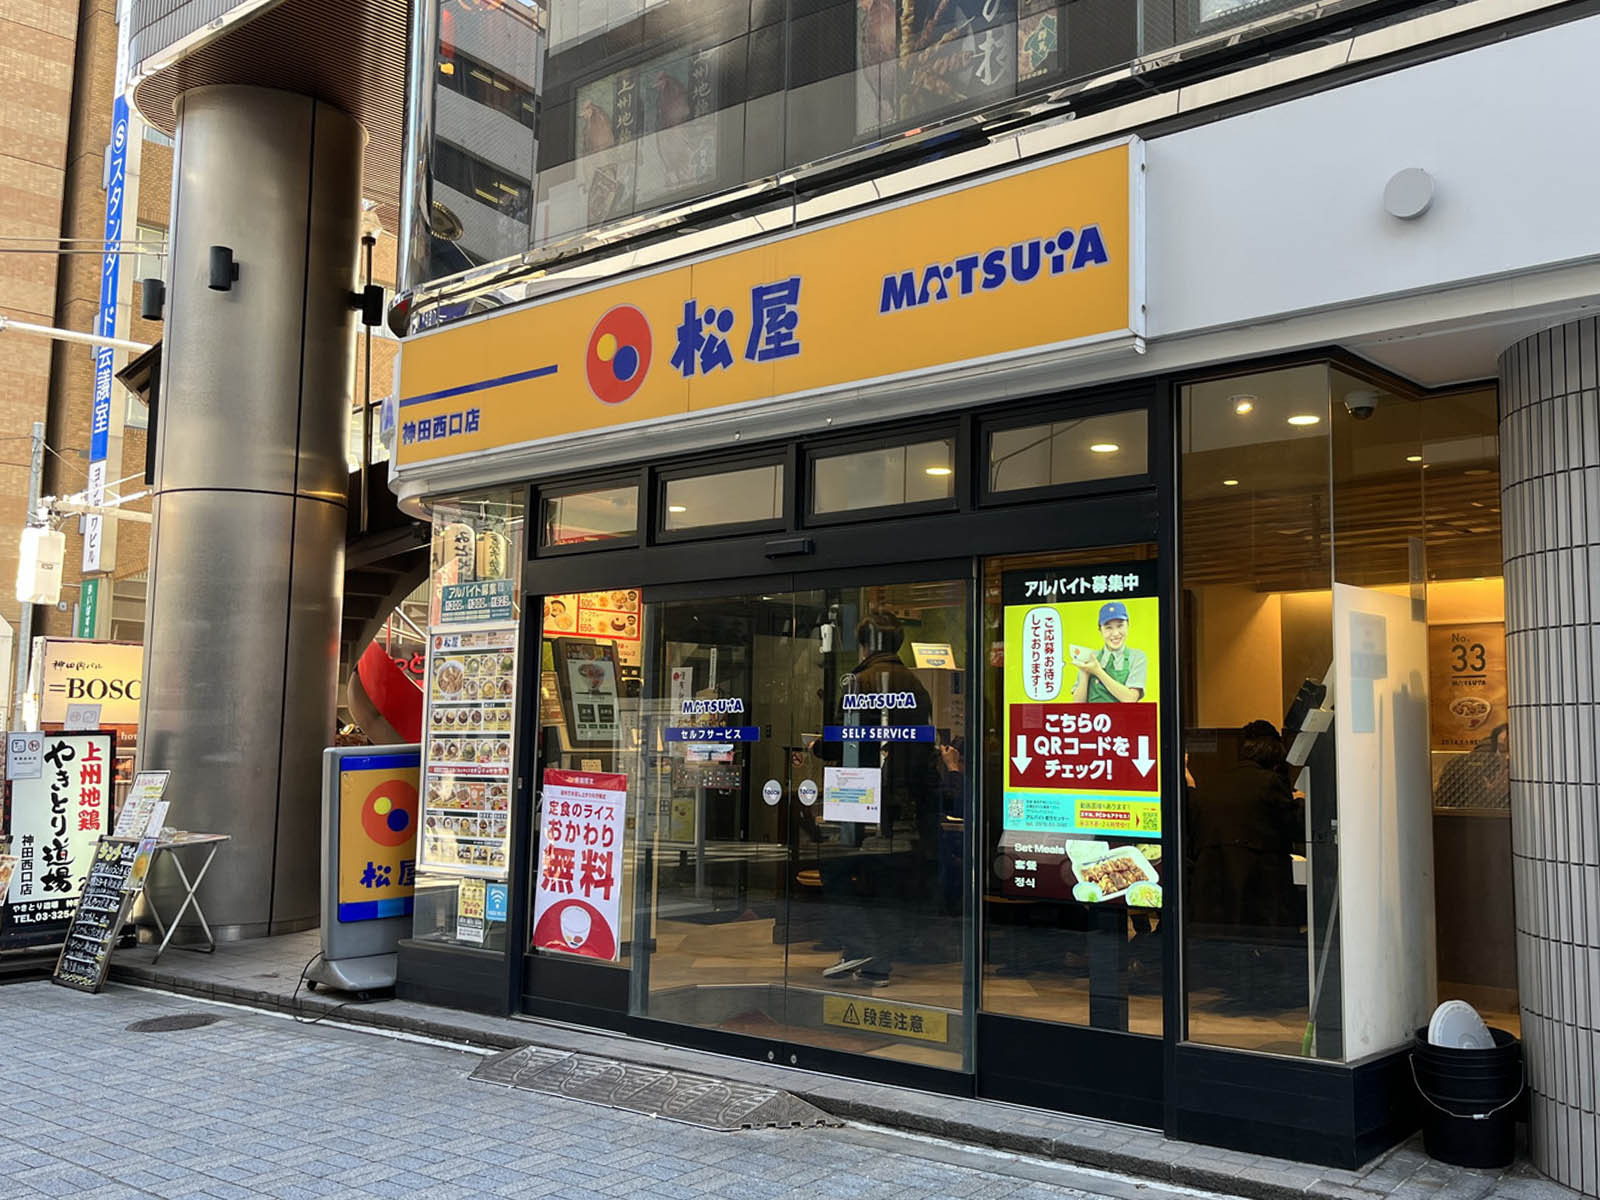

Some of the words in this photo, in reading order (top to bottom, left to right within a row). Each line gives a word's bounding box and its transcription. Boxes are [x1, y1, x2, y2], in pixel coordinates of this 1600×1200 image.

[879, 223, 1108, 314] MATSUYA
[669, 276, 801, 377] 松屋
[402, 408, 480, 444] 神田西口店
[1025, 574, 1139, 597] アルバイト募集中
[1031, 614, 1041, 698] しております!
[1044, 616, 1055, 693] ご応募お待ち
[1450, 643, 1486, 673] 33
[682, 698, 744, 714] MATSUYA
[842, 692, 917, 709] MATSUYA
[680, 729, 742, 739] セルフサービス
[841, 728, 866, 739] SELF
[869, 728, 917, 739] SERVICE
[1045, 713, 1111, 733] こちらの
[1033, 736, 1130, 757] QRコードを
[1045, 759, 1113, 780] チェック!
[78, 741, 103, 831] 上州地鶏
[40, 740, 76, 893] やきとり道場
[548, 800, 615, 821] 定食のライス
[548, 819, 615, 848] おかわり
[20, 834, 35, 895] 神田西口店
[541, 847, 614, 901] 無料
[1014, 876, 1035, 889] 정식
[863, 1008, 924, 1033] 段差注意
